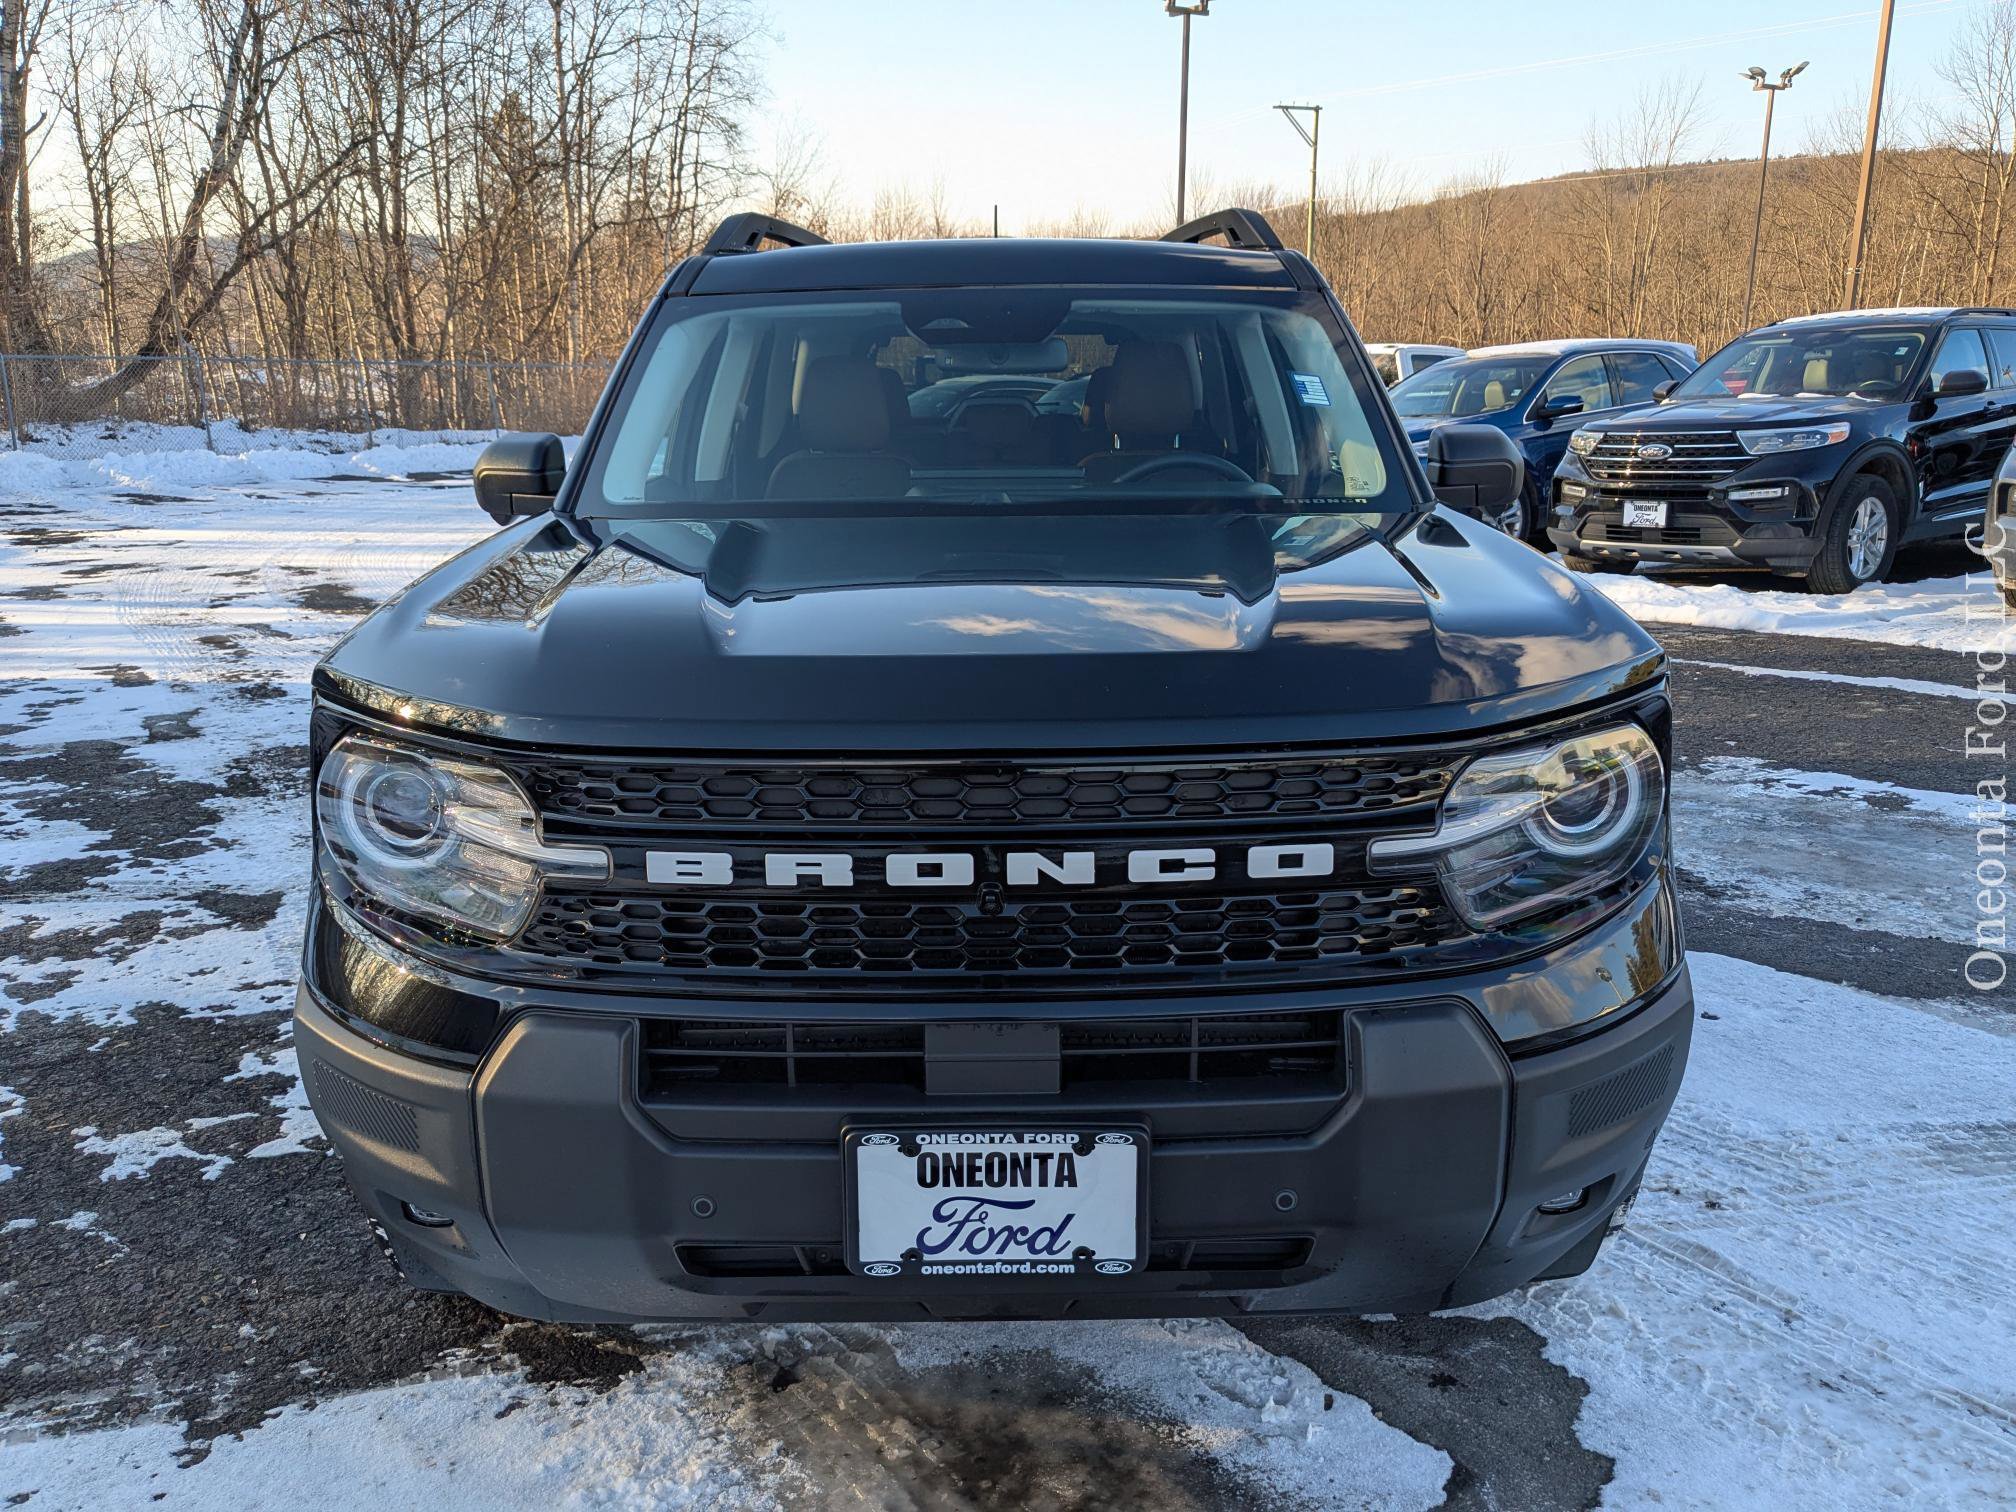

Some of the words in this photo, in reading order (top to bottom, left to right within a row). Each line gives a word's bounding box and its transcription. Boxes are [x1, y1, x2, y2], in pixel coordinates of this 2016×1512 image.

[1632, 512, 1657, 525] Ford
[645, 843, 1334, 886] BRONCO
[915, 1133, 1020, 1145] ONEONTA
[1023, 1133, 1080, 1145] FORD
[916, 1151, 1078, 1189] ONEONTA
[915, 1196, 1076, 1256] Ford
[920, 1261, 1075, 1275] oneontaford.com
